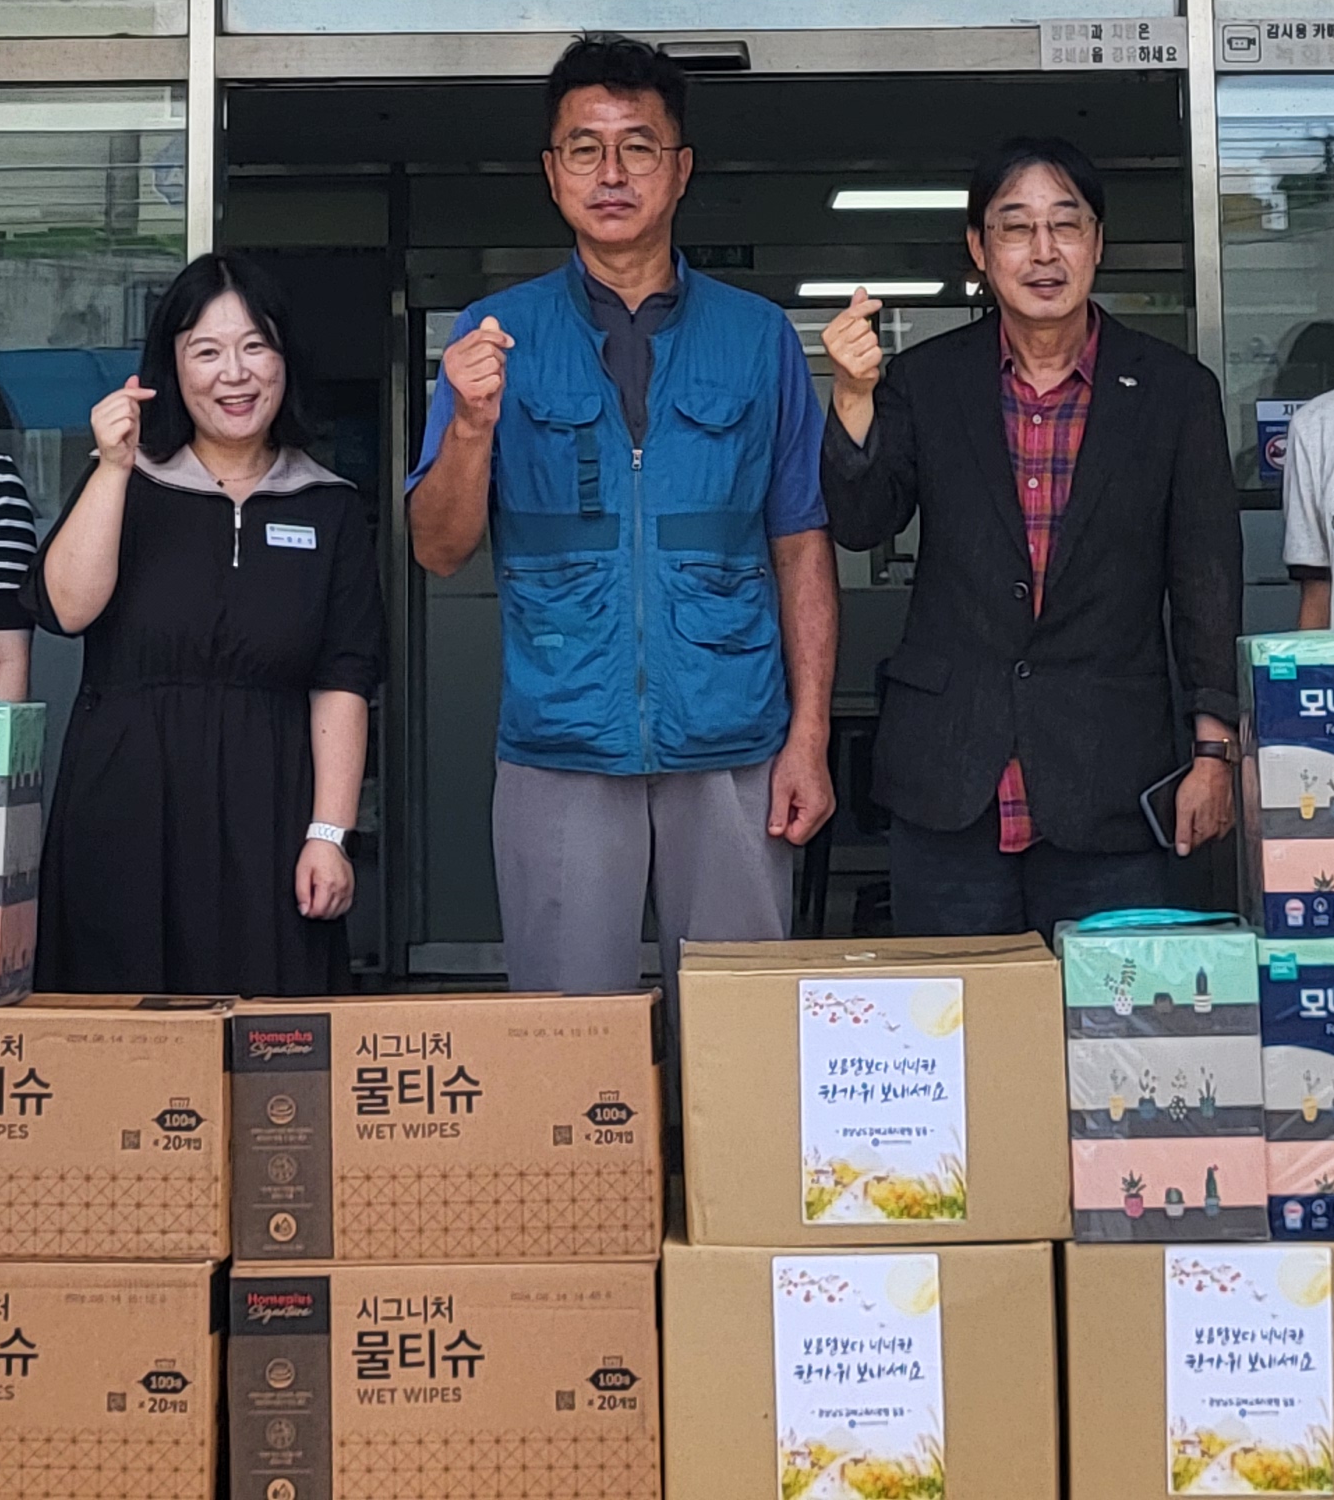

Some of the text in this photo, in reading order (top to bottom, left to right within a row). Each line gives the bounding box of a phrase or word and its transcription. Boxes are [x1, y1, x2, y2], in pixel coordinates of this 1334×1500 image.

[1266, 23, 1307, 40] 감시용
[249, 1031, 313, 1045] Homeplus
[356, 1032, 452, 1061] 시그니처
[351, 1064, 483, 1117] 물티슈
[880, 1081, 948, 1103] 보내세요
[356, 1122, 462, 1141] WET WIPES
[356, 1295, 454, 1325] 시그니처
[351, 1329, 485, 1380] 물티슈
[1247, 1351, 1316, 1374] 보내세요
[856, 1361, 926, 1385] 보내세요
[356, 1387, 463, 1405] WET WIPES
